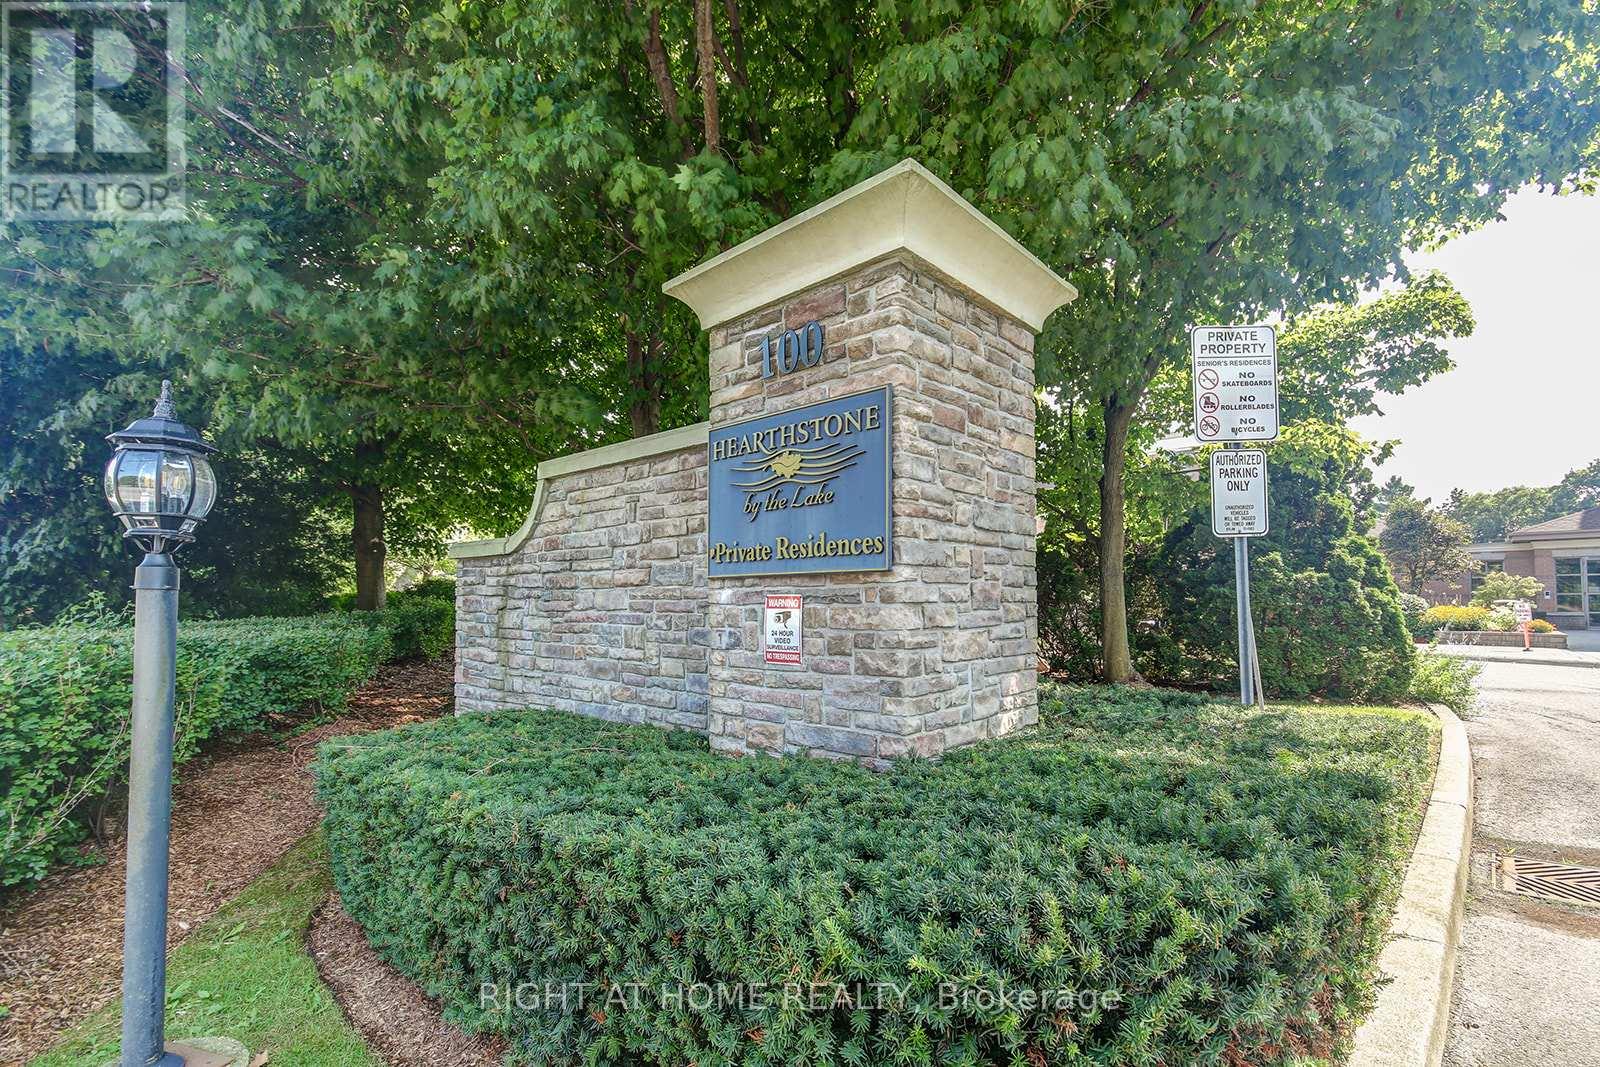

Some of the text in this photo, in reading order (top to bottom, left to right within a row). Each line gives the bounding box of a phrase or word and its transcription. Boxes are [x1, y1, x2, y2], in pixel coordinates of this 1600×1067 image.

[1207, 331, 1258, 341] PRIVATE
[757, 320, 823, 380] 100
[1200, 343, 1266, 354] PROPERTY
[1238, 371, 1256, 379] NO
[1239, 395, 1256, 403] NO
[1220, 403, 1275, 411] ROLLERBLADES
[712, 404, 881, 463] HEARTHSTONE
[1231, 426, 1266, 434] BICYCLES
[1215, 454, 1262, 466] AUTHORIZED
[1219, 467, 1259, 479] PARKING
[1226, 480, 1250, 492] ONLY
[743, 483, 835, 523] by the Lake
[714, 532, 884, 564] Private Residences
[768, 599, 799, 608] WARNING
